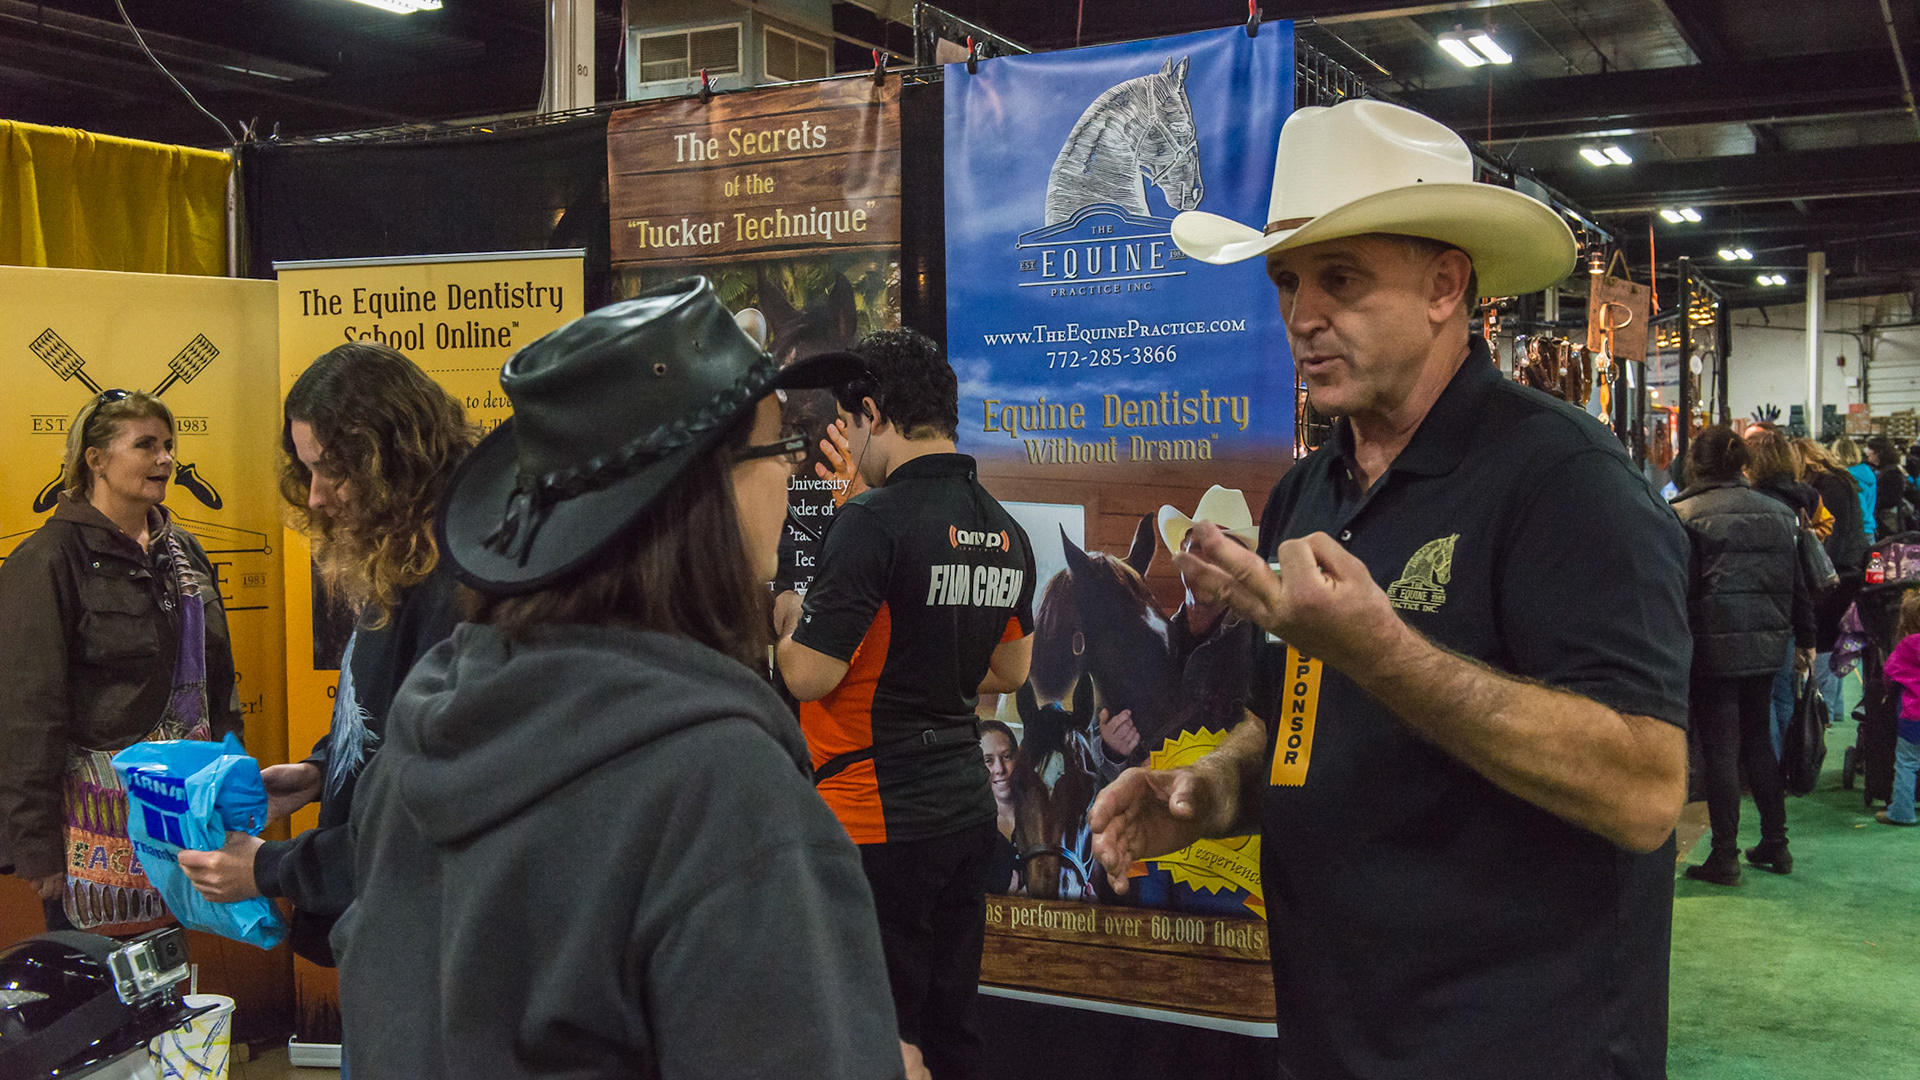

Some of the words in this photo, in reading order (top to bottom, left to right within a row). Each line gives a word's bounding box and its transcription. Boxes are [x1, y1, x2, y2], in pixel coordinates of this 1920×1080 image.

[577, 64, 588, 77] 80
[674, 132, 719, 162] The
[728, 120, 827, 157] Secrets
[724, 176, 740, 197] of
[746, 174, 774, 195] the
[1091, 225, 1114, 234] THE
[1042, 242, 1165, 279] EQUINE
[299, 289, 342, 316] The
[353, 286, 436, 318] Equine
[447, 281, 563, 313] Dentistry
[1051, 285, 1122, 297] PRACTICE
[1127, 282, 1155, 292] INC.
[1046, 345, 1177, 369] 772-285-3866
[466, 395, 479, 408] to
[983, 397, 1085, 438] Equine
[1103, 390, 1250, 431] Dentistry
[177, 420, 207, 432] 1983
[1024, 436, 1117, 464] Without
[821, 499, 835, 516] of
[242, 576, 266, 585] 1983
[926, 565, 970, 606] FILM
[973, 565, 1024, 608] CREW
[1400, 589, 1428, 601] EQUINE
[72, 840, 145, 875] EACE
[985, 902, 1003, 923] as
[1010, 903, 1096, 933] performed
[1105, 916, 1142, 937] over
[1151, 915, 1205, 943] 60,000
[1213, 921, 1263, 950] floats
